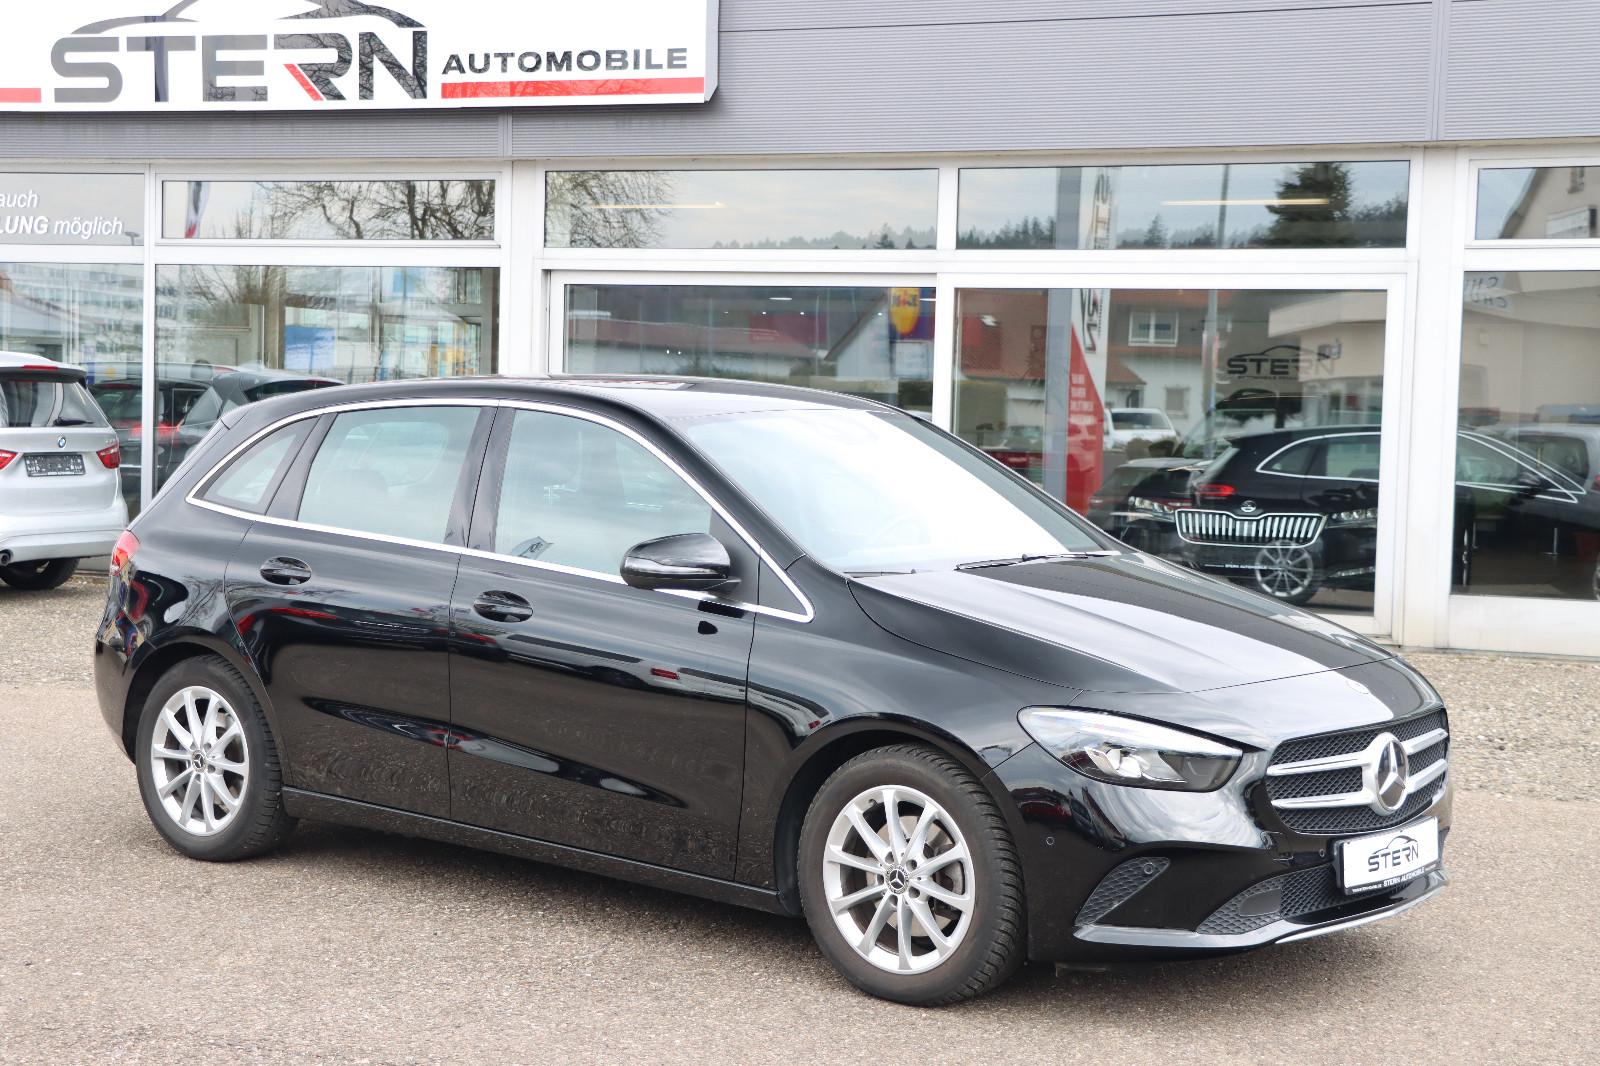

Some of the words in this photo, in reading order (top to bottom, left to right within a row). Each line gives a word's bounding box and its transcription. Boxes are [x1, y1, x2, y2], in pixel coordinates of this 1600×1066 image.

[51, 31, 427, 103] STERN
[441, 47, 688, 75] AUTOMOBILE
[54, 216, 123, 239] möglich
[1227, 358, 1334, 375] STERN
[1368, 842, 1418, 873] STERN
[1383, 877, 1400, 887] STERN
